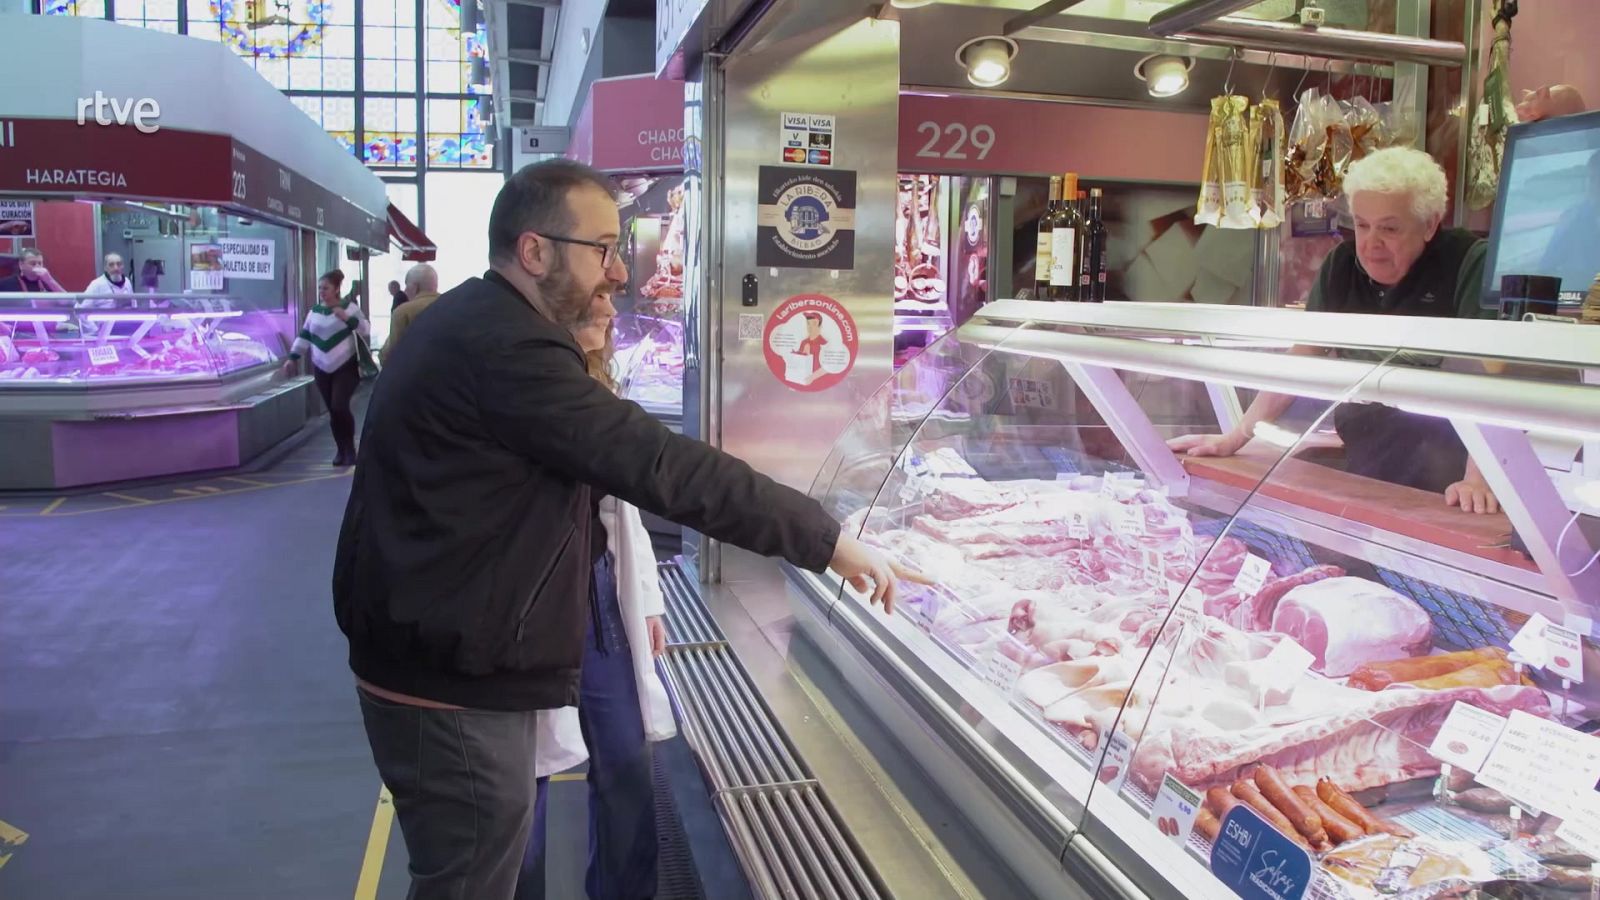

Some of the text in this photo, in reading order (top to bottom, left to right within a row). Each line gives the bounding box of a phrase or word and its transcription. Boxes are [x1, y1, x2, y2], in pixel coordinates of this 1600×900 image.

[787, 116, 806, 125] VISA
[812, 119, 831, 127] VISA
[916, 121, 995, 160] 229
[26, 168, 127, 187] HARATEGIA
[233, 170, 246, 199] 223
[222, 243, 269, 256] ESPECIALIDAD EN
[790, 238, 821, 249] BILBAO
[222, 260, 271, 273] HULETAS DE BUEY
[1225, 819, 1252, 848] ESHBI
